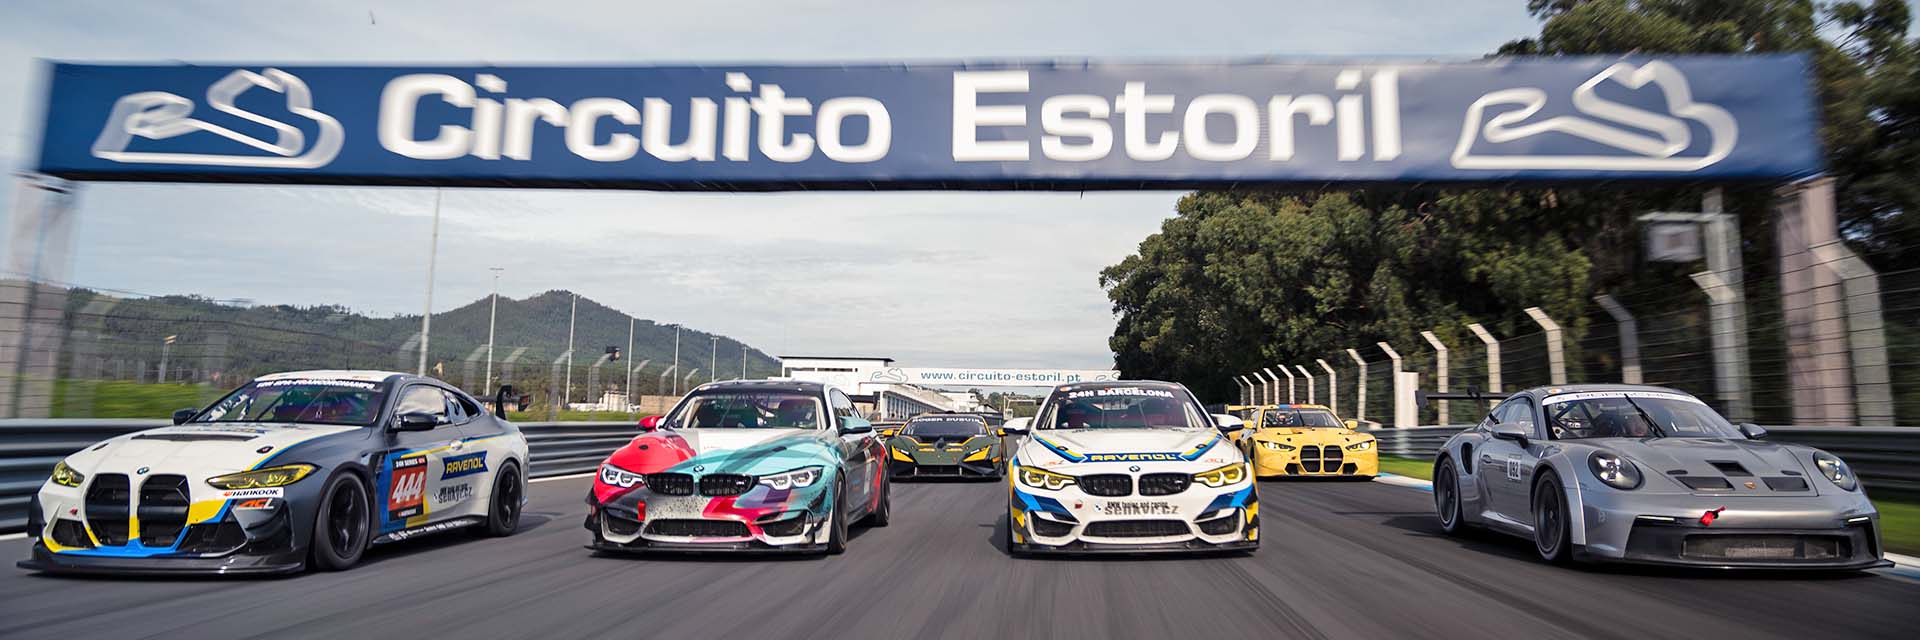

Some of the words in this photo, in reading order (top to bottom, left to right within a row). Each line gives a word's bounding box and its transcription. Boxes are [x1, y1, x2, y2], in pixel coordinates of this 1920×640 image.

[378, 73, 892, 163] Circuito
[953, 69, 1402, 161] Estoril
[920, 371, 1081, 383] www.circuito-estoril.pt
[1068, 391, 1095, 399] 24H
[1097, 389, 1174, 398] BARCELONA
[1090, 453, 1177, 461] RAVENOL
[446, 457, 484, 474] RAVENOL
[392, 471, 424, 504] 444
